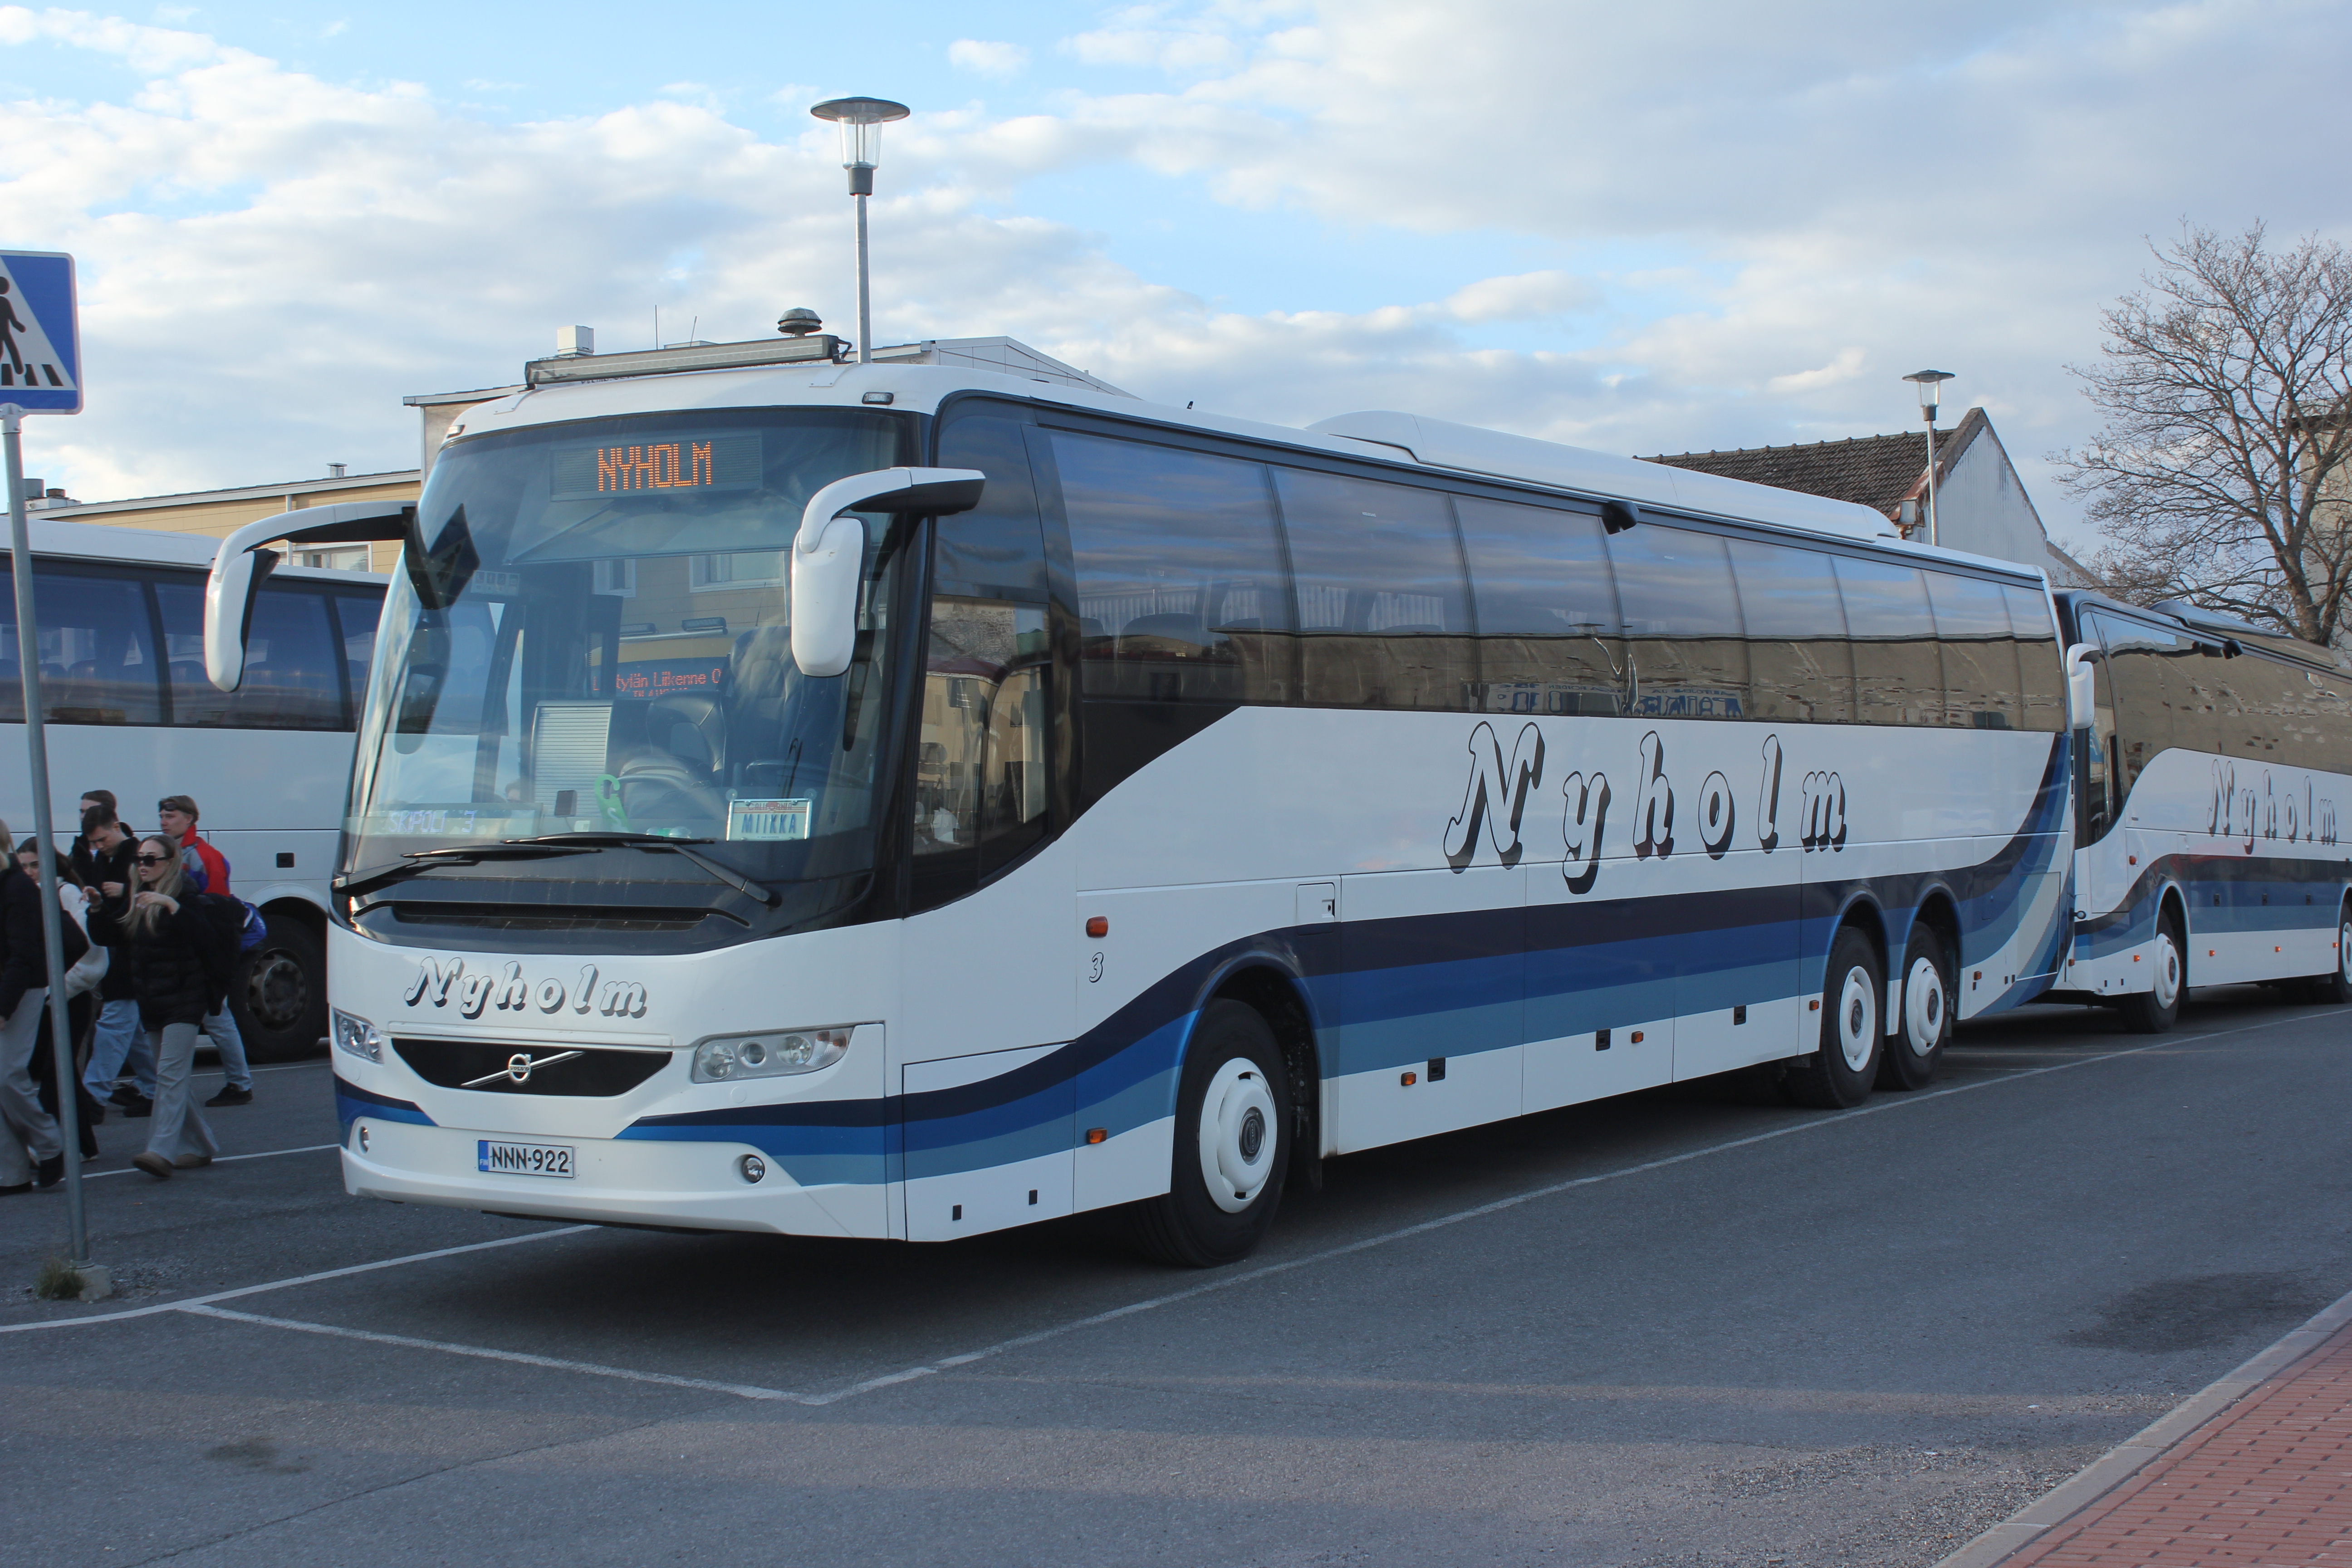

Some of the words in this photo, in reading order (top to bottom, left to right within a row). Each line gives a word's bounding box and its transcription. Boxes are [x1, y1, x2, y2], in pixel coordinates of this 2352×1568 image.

[598, 442, 711, 491] NYHOLM
[593, 673, 649, 691] Ltylän
[654, 671, 706, 686] Liikenne
[461, 811, 475, 833] 3
[1443, 721, 1847, 894] Nyholm
[2207, 759, 2336, 855] Nyholm
[741, 813, 796, 833] MIIKKA
[1089, 952, 1104, 983] 3
[404, 956, 647, 1020] Nyholm
[492, 1146, 569, 1173] NNN-922
